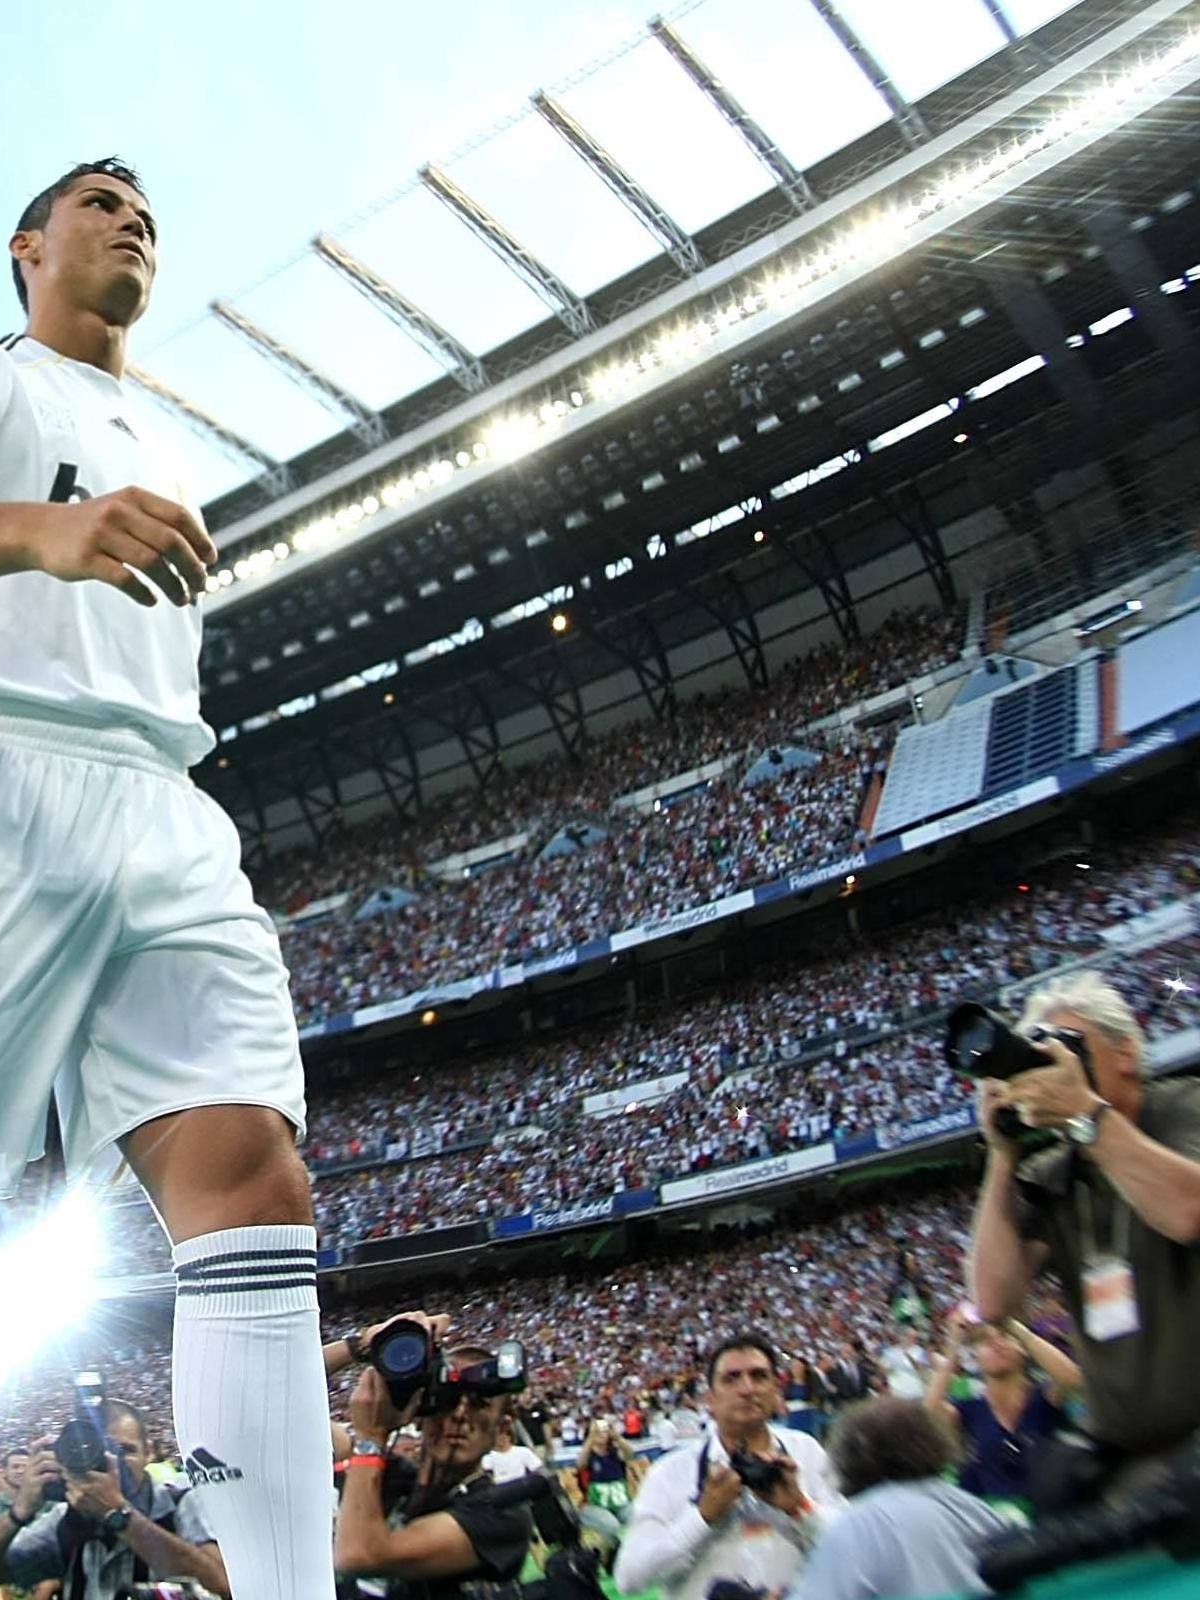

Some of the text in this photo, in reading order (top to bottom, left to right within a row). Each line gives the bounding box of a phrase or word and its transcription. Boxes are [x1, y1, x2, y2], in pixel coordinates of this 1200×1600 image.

[789, 851, 867, 892] Realmadrid
[704, 1159, 788, 1191] Realmadrid
[532, 1195, 613, 1230] Realmadrid
